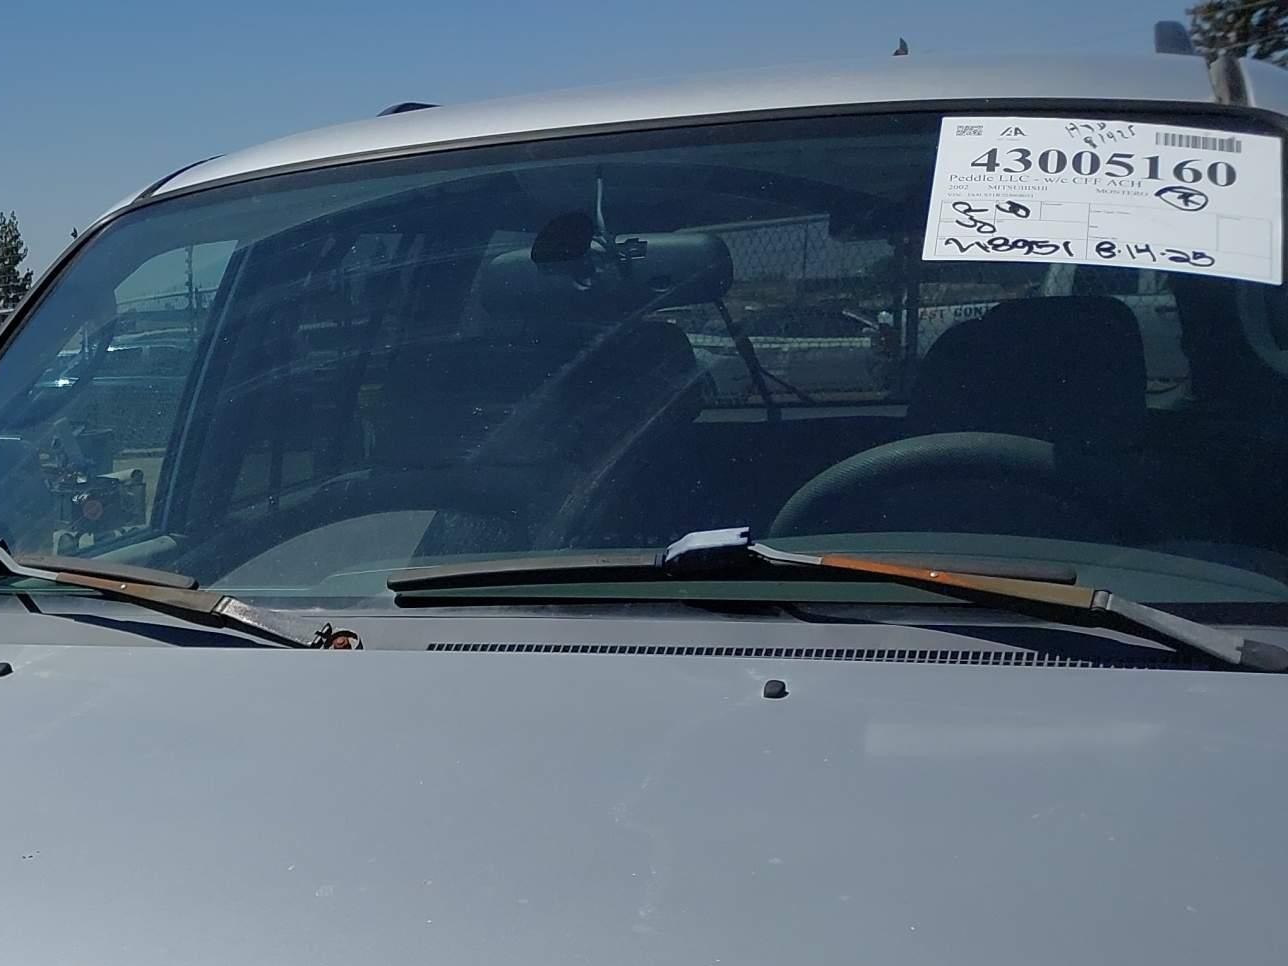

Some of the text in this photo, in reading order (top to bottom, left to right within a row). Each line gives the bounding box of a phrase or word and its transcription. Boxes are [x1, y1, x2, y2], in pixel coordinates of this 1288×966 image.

[970, 147, 1237, 188] 43005160
[949, 174, 995, 182] Peddle
[999, 175, 1030, 183] LLC
[1106, 179, 1143, 188] ACH
[1095, 187, 1150, 197] MONTERO
